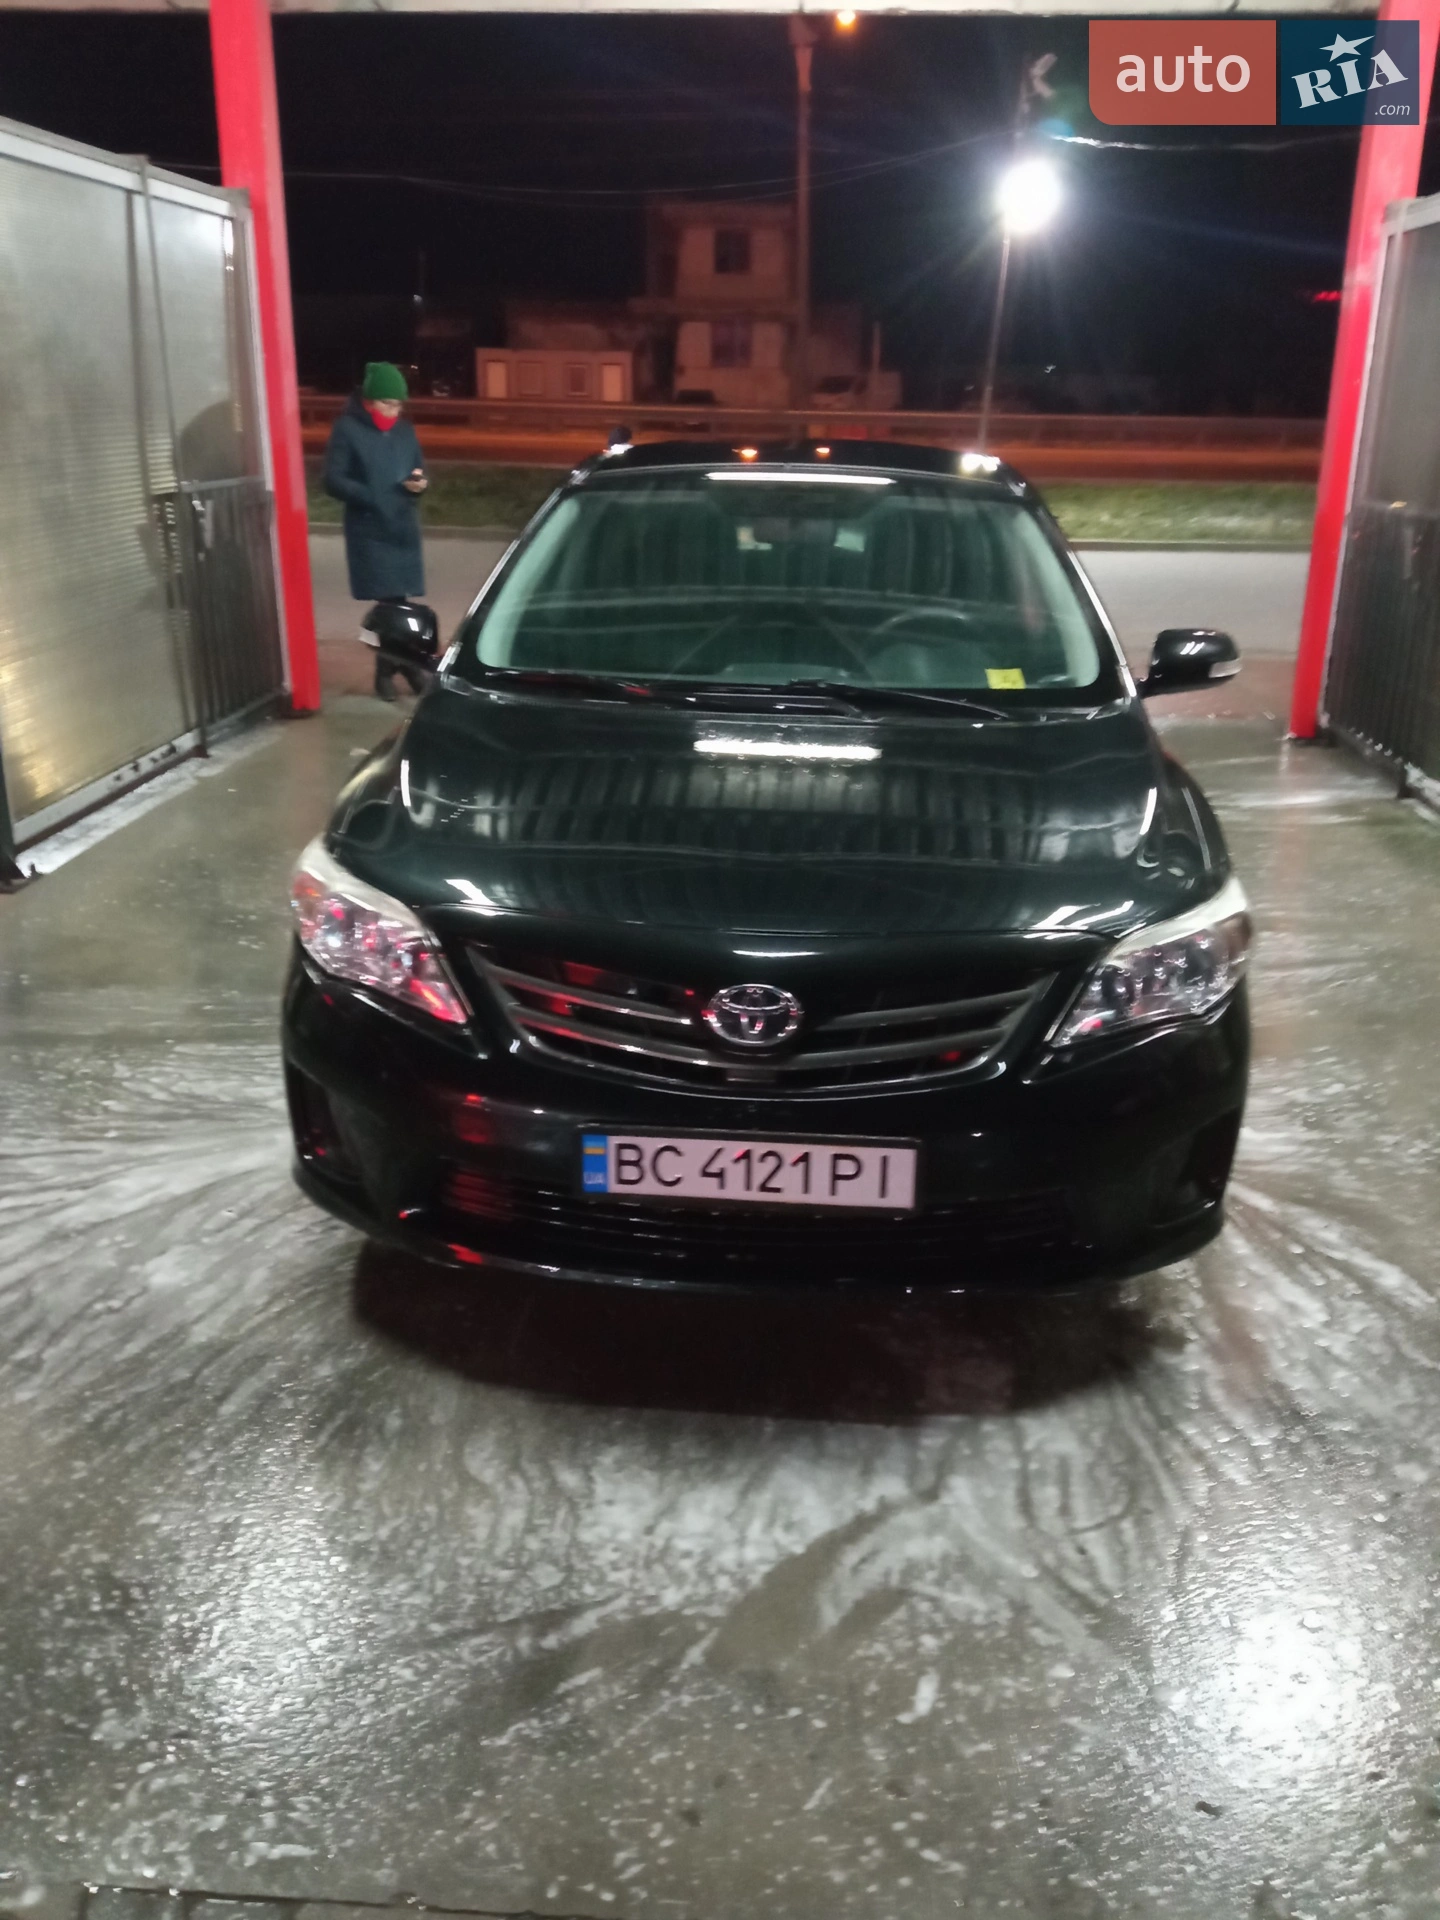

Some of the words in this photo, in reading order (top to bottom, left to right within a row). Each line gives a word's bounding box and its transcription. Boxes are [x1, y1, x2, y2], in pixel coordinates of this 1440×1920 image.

[614, 1143, 683, 1188] BC
[699, 1147, 811, 1195] 4121
[829, 1153, 889, 1199] PI
